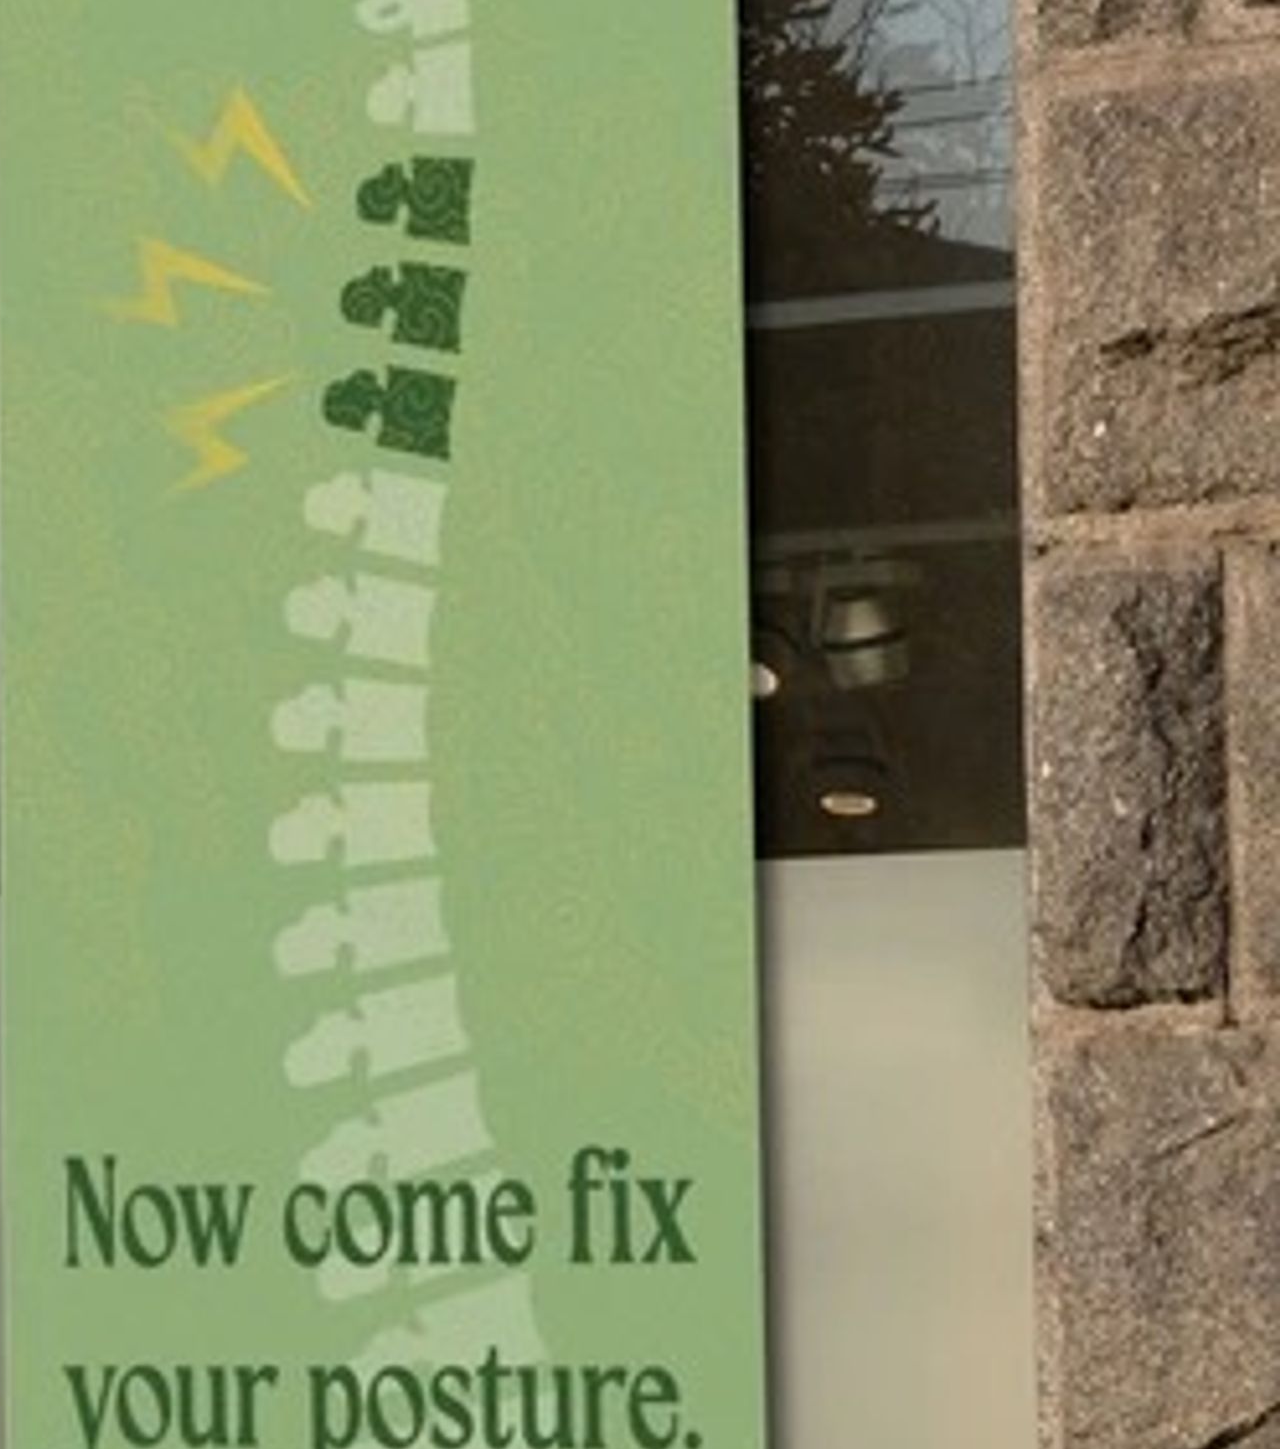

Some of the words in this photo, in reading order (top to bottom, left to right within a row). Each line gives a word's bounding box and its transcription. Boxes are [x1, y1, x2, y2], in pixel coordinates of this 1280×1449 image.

[64, 1154, 255, 1270] Now
[282, 1178, 538, 1270] come
[566, 1144, 698, 1265] fix
